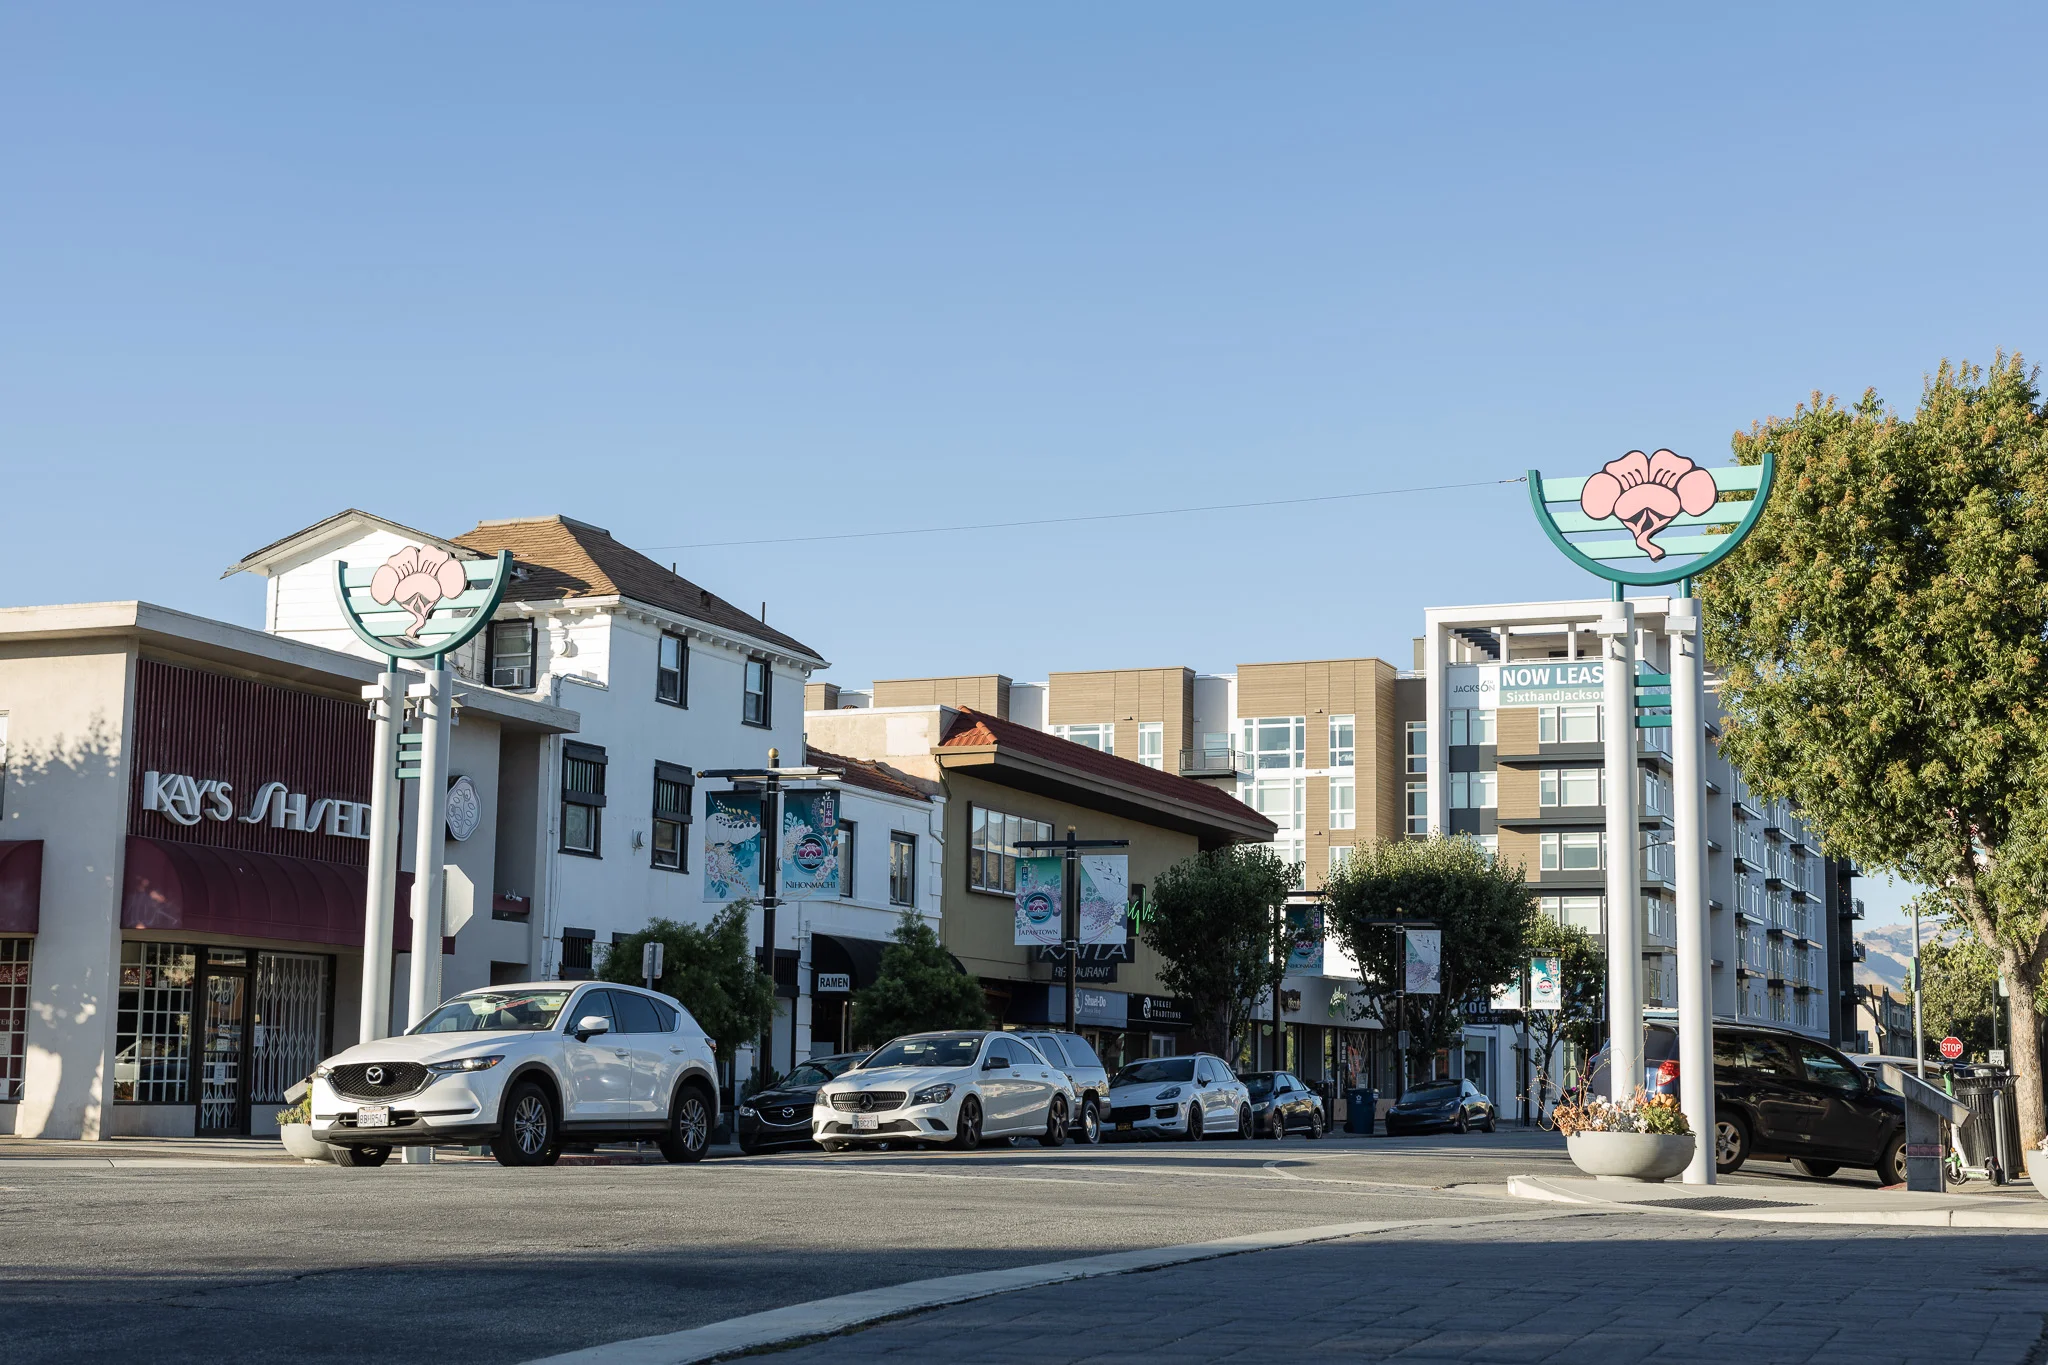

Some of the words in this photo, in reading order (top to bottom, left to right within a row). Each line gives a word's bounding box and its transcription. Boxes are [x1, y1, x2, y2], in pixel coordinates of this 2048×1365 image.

[1502, 668, 1550, 687] NOW
[1556, 664, 1640, 686] LEAS
[143, 770, 233, 826] KAY'S
[238, 781, 401, 842] SHISEID
[785, 880, 836, 889] NIHONMACHI
[1018, 928, 1058, 936] JAPANTOWN
[1055, 966, 1111, 978] REAURANT
[820, 977, 849, 988] RAMEN
[1152, 1000, 1172, 1009] NIKKEI
[1152, 1009, 1182, 1019] TRADITIONS
[1942, 1043, 1962, 1052] STOP
